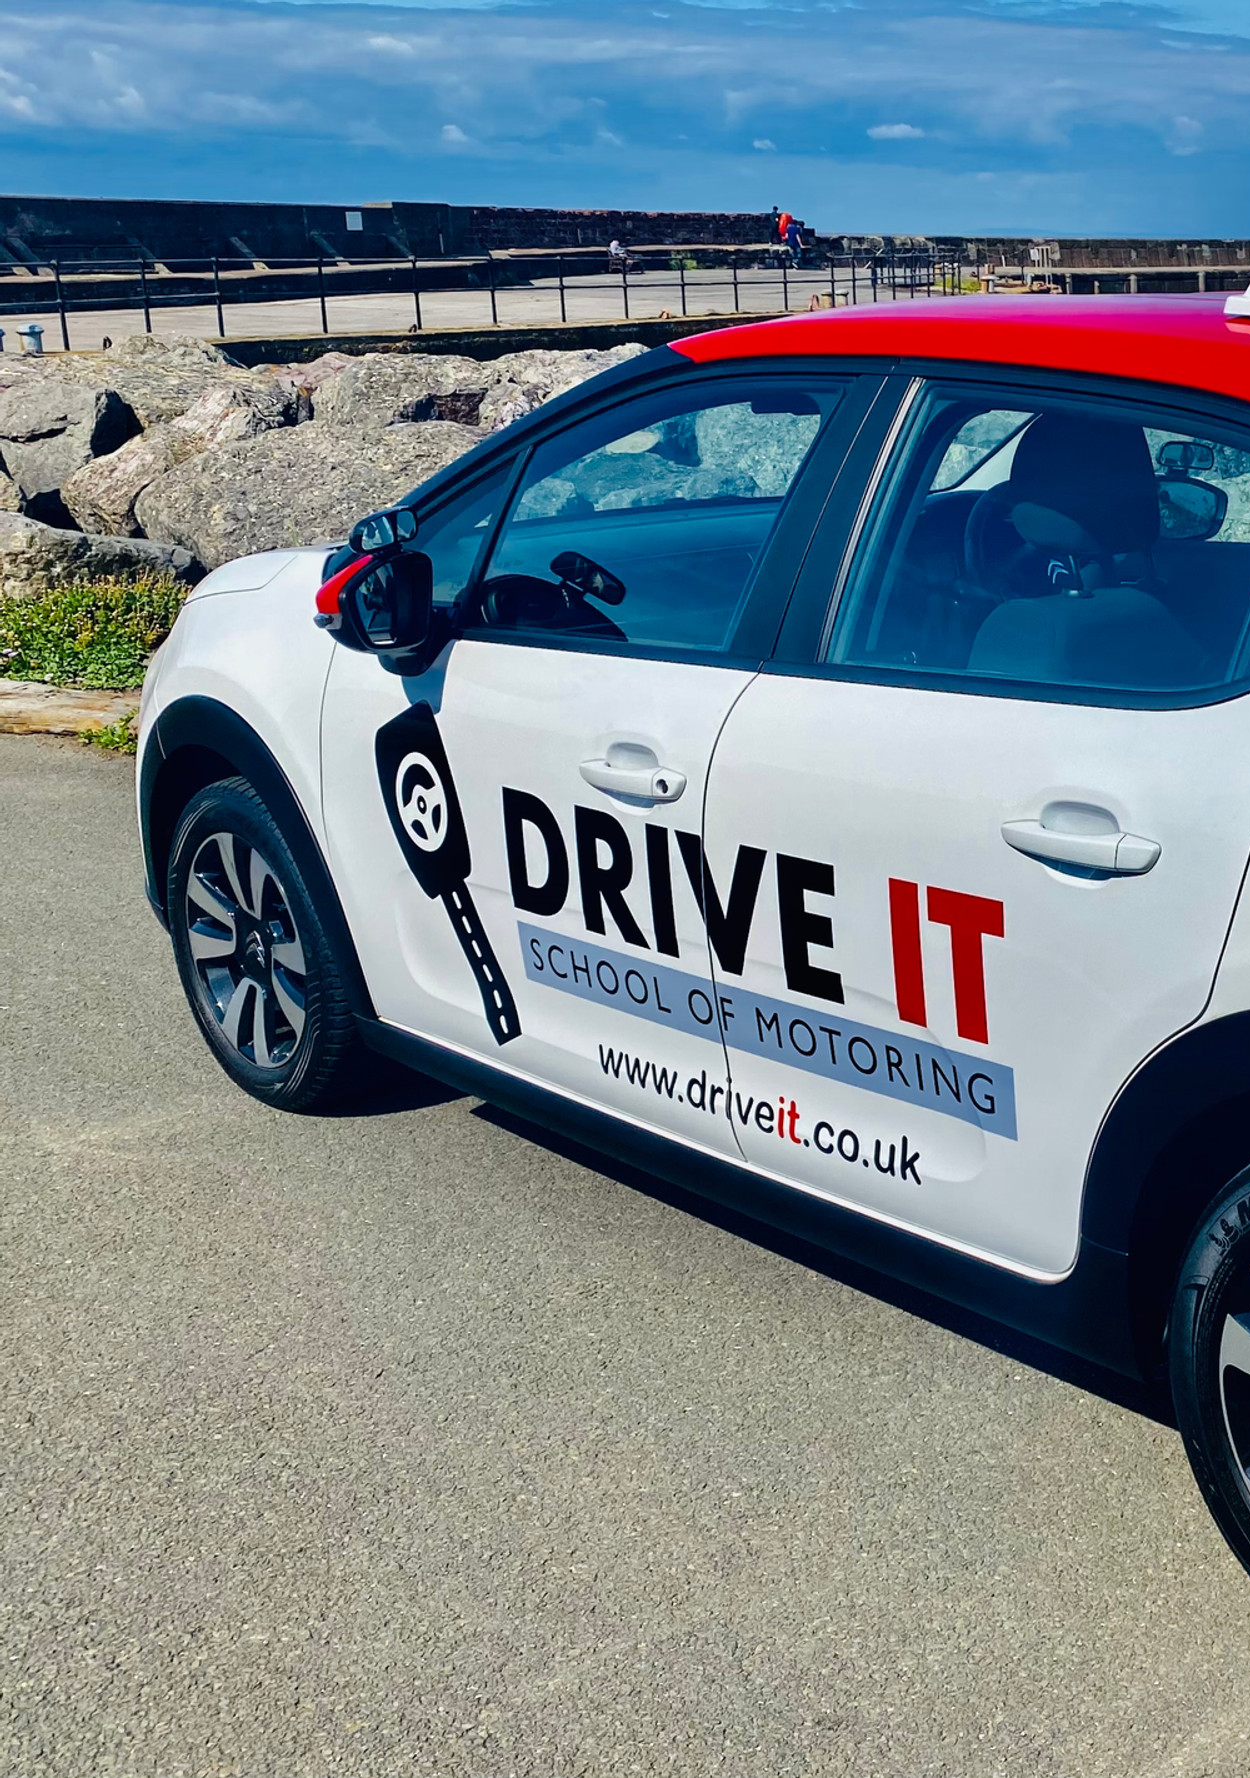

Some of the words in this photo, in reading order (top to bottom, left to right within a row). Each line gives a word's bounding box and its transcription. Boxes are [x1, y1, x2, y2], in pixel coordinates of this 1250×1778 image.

[501, 785, 845, 1005] DRIVE
[888, 876, 1005, 1045] IT
[529, 937, 672, 1014] SCHOOL
[687, 988, 736, 1033] OF
[755, 1005, 997, 1115] MOTORING
[597, 1043, 923, 1187] www.driveit.co.uk
